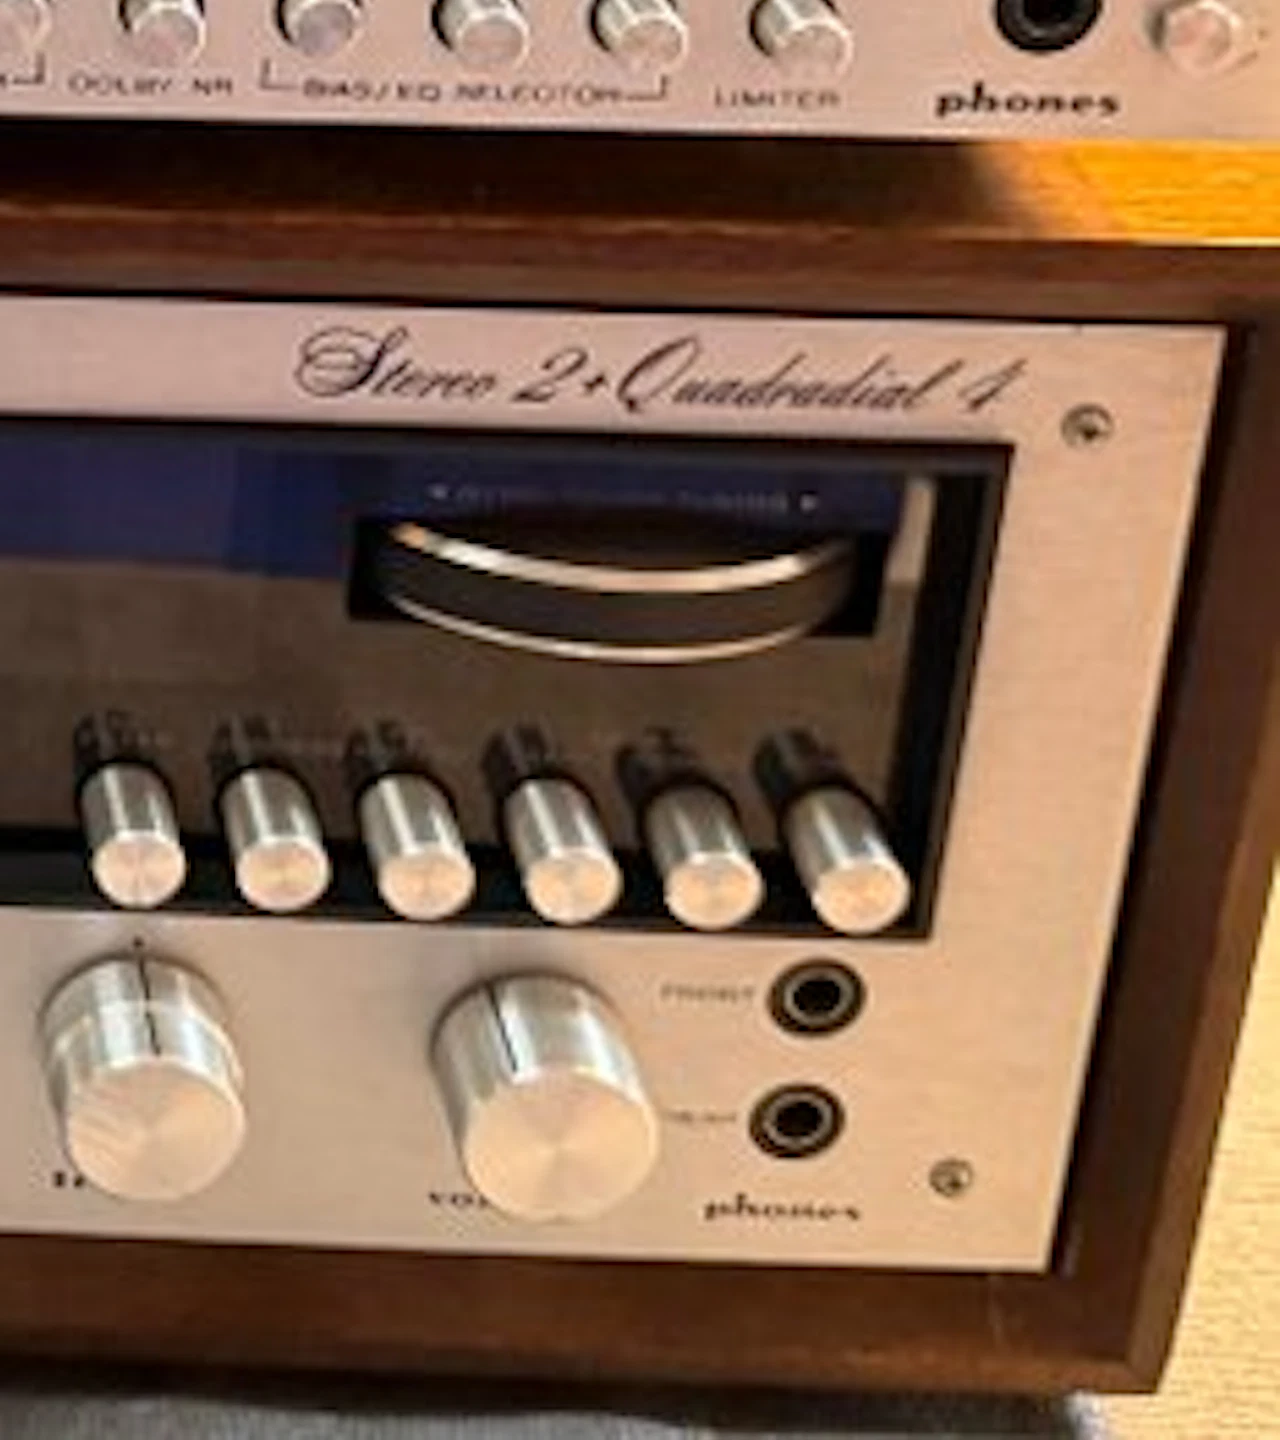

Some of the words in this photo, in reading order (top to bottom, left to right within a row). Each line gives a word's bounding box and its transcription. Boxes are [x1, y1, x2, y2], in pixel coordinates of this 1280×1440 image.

[714, 88, 841, 110] LIMITER
[934, 81, 1122, 120] phones
[296, 324, 497, 400] Stereo
[959, 357, 1029, 412] 4
[704, 1192, 863, 1223] phones
